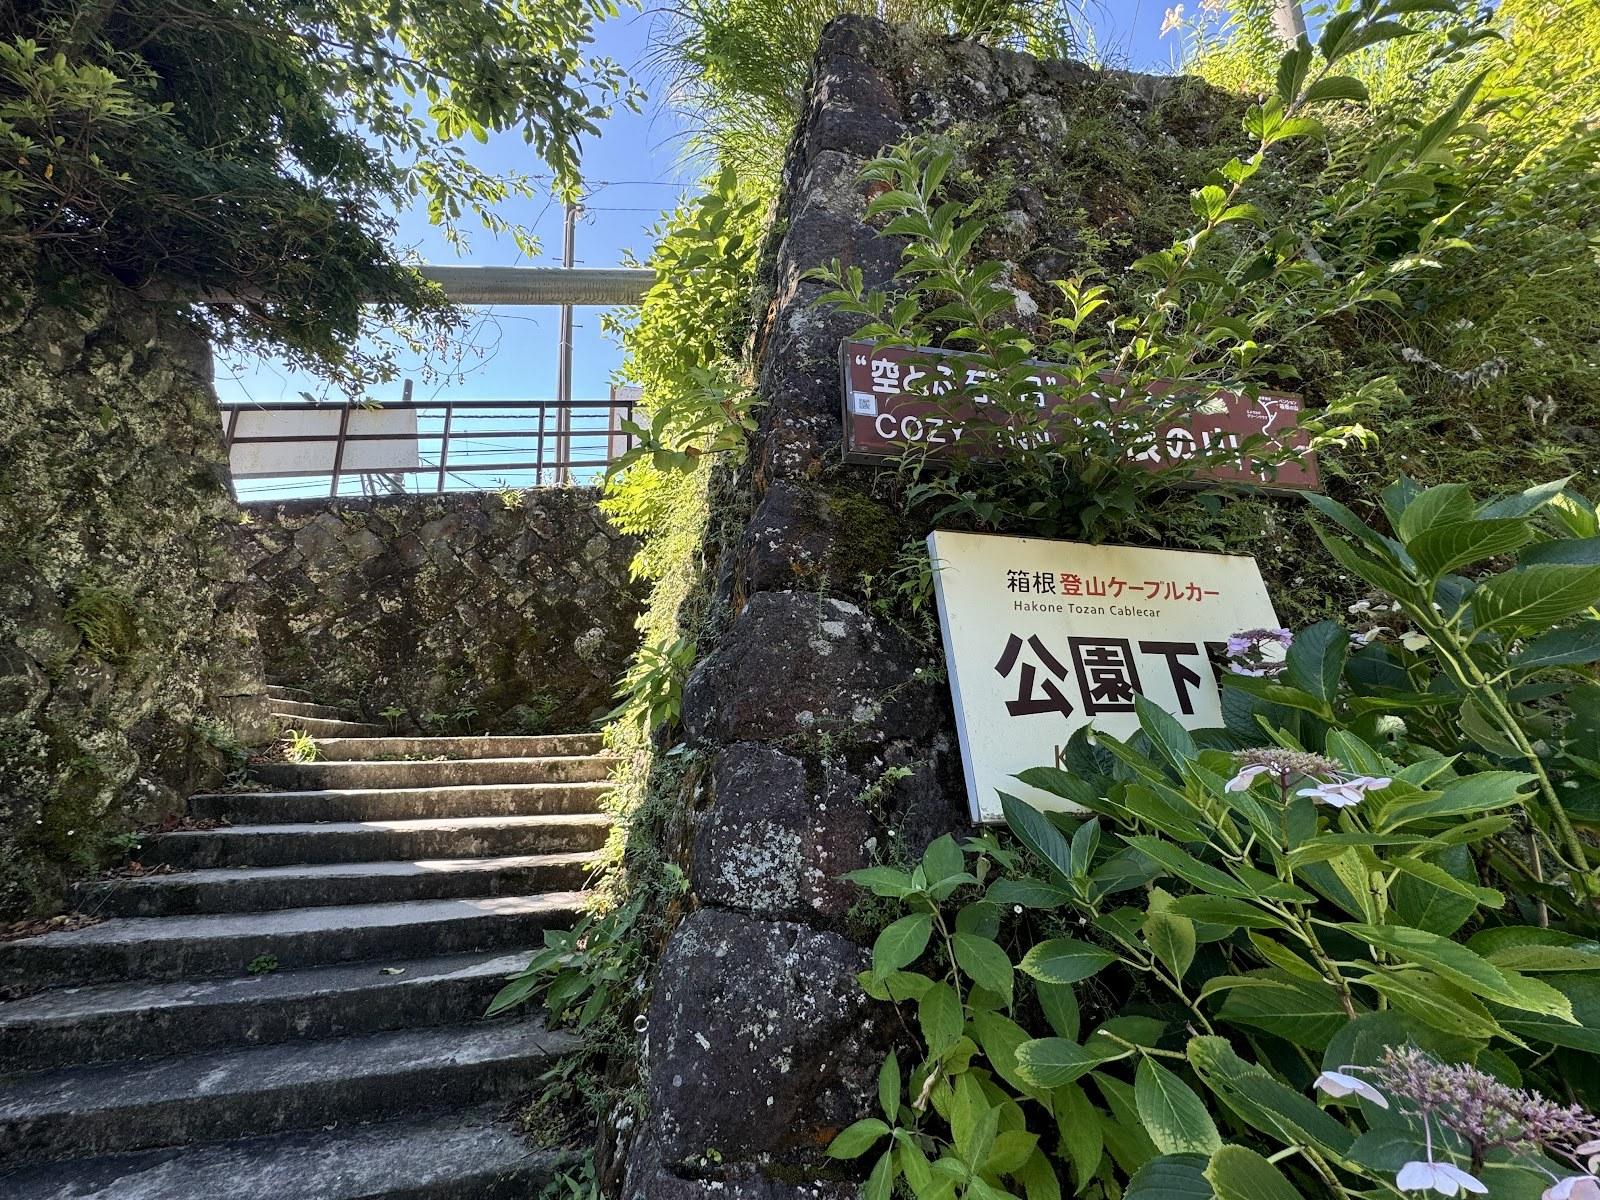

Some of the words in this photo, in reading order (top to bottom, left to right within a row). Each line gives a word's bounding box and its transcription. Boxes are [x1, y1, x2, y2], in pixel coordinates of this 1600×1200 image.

[1013, 600, 1063, 614] Hakone
[1067, 604, 1106, 616] Tozan
[1110, 605, 1161, 619] Cablecar
[994, 633, 1229, 719] 公園下
